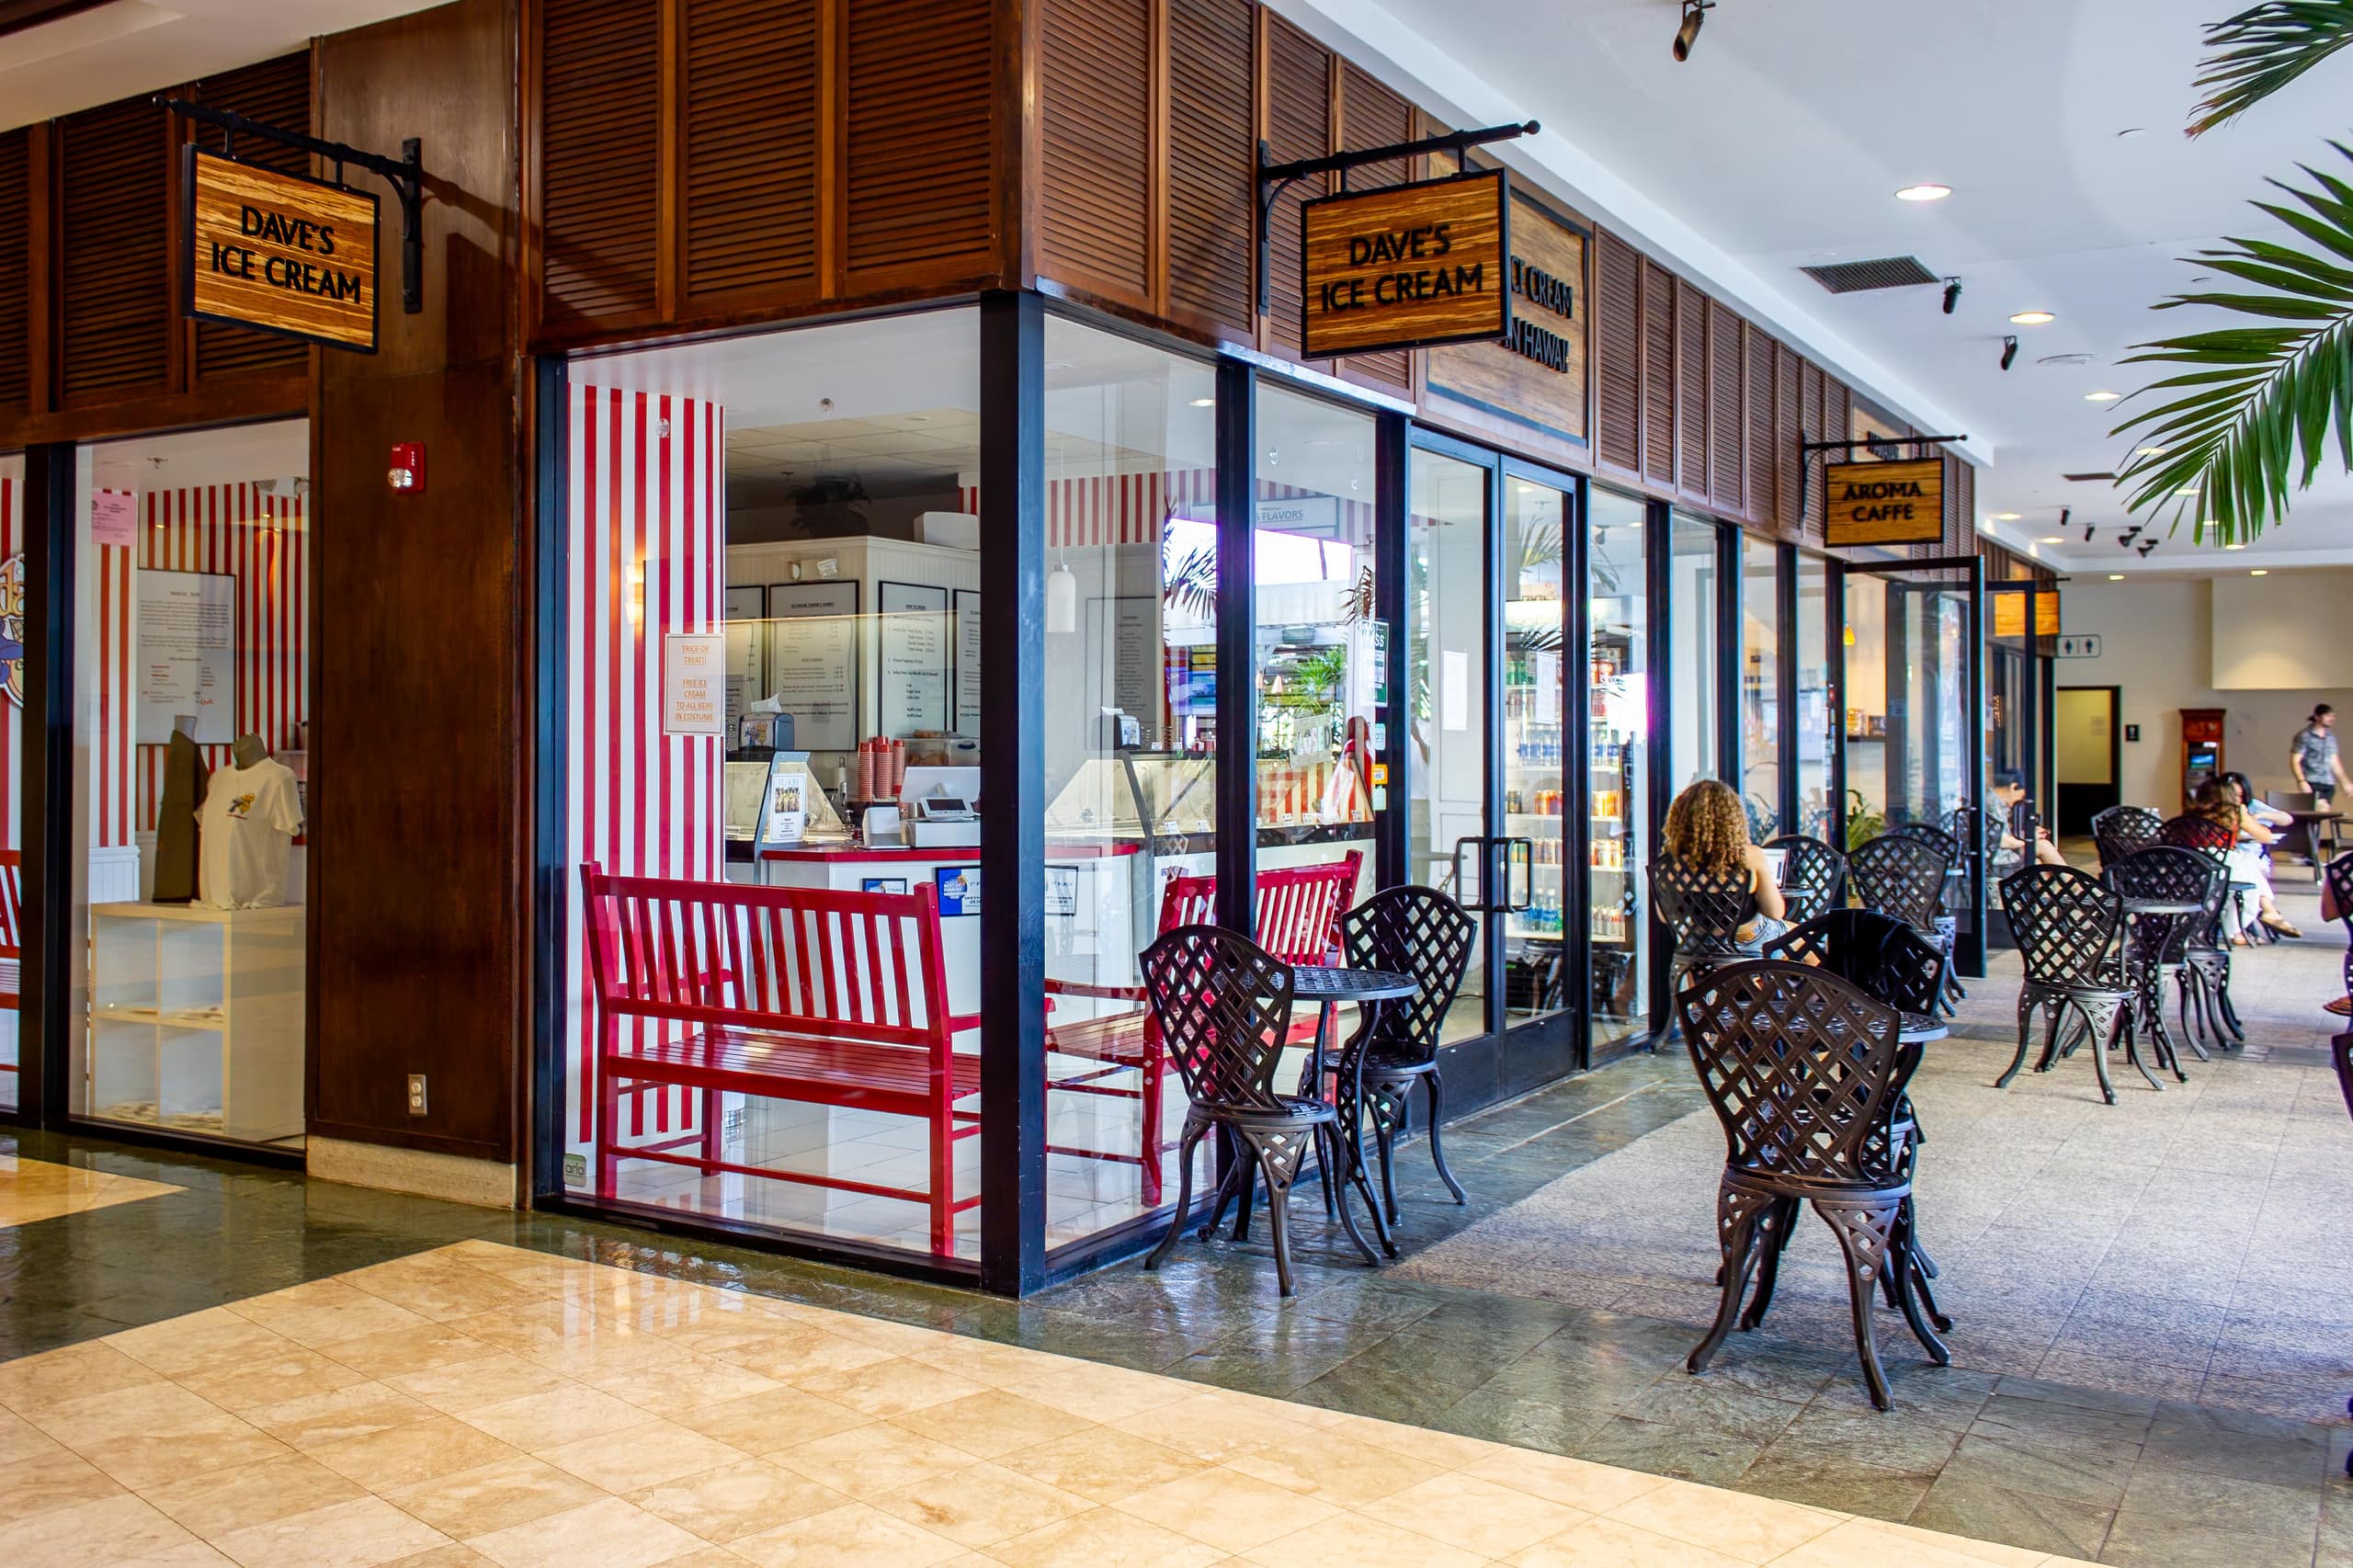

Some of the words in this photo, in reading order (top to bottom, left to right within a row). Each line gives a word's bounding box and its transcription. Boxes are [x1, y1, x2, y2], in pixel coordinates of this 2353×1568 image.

[241, 205, 335, 256] DAVE'S
[1349, 224, 1451, 267] DAVE'S
[211, 242, 256, 280] ICE
[265, 256, 361, 305] CREAM
[1322, 278, 1364, 312] ICE
[1375, 263, 1483, 305] CREAM
[1510, 256, 1528, 295] CE
[1528, 266, 1574, 319] CREAM
[1843, 482, 1922, 501] AROMA
[1262, 509, 1303, 521] FLAVORS
[1852, 504, 1914, 523] CAFFE
[676, 712, 682, 721] IN
[683, 712, 713, 722] COSTUME
[686, 701, 696, 710] ALL
